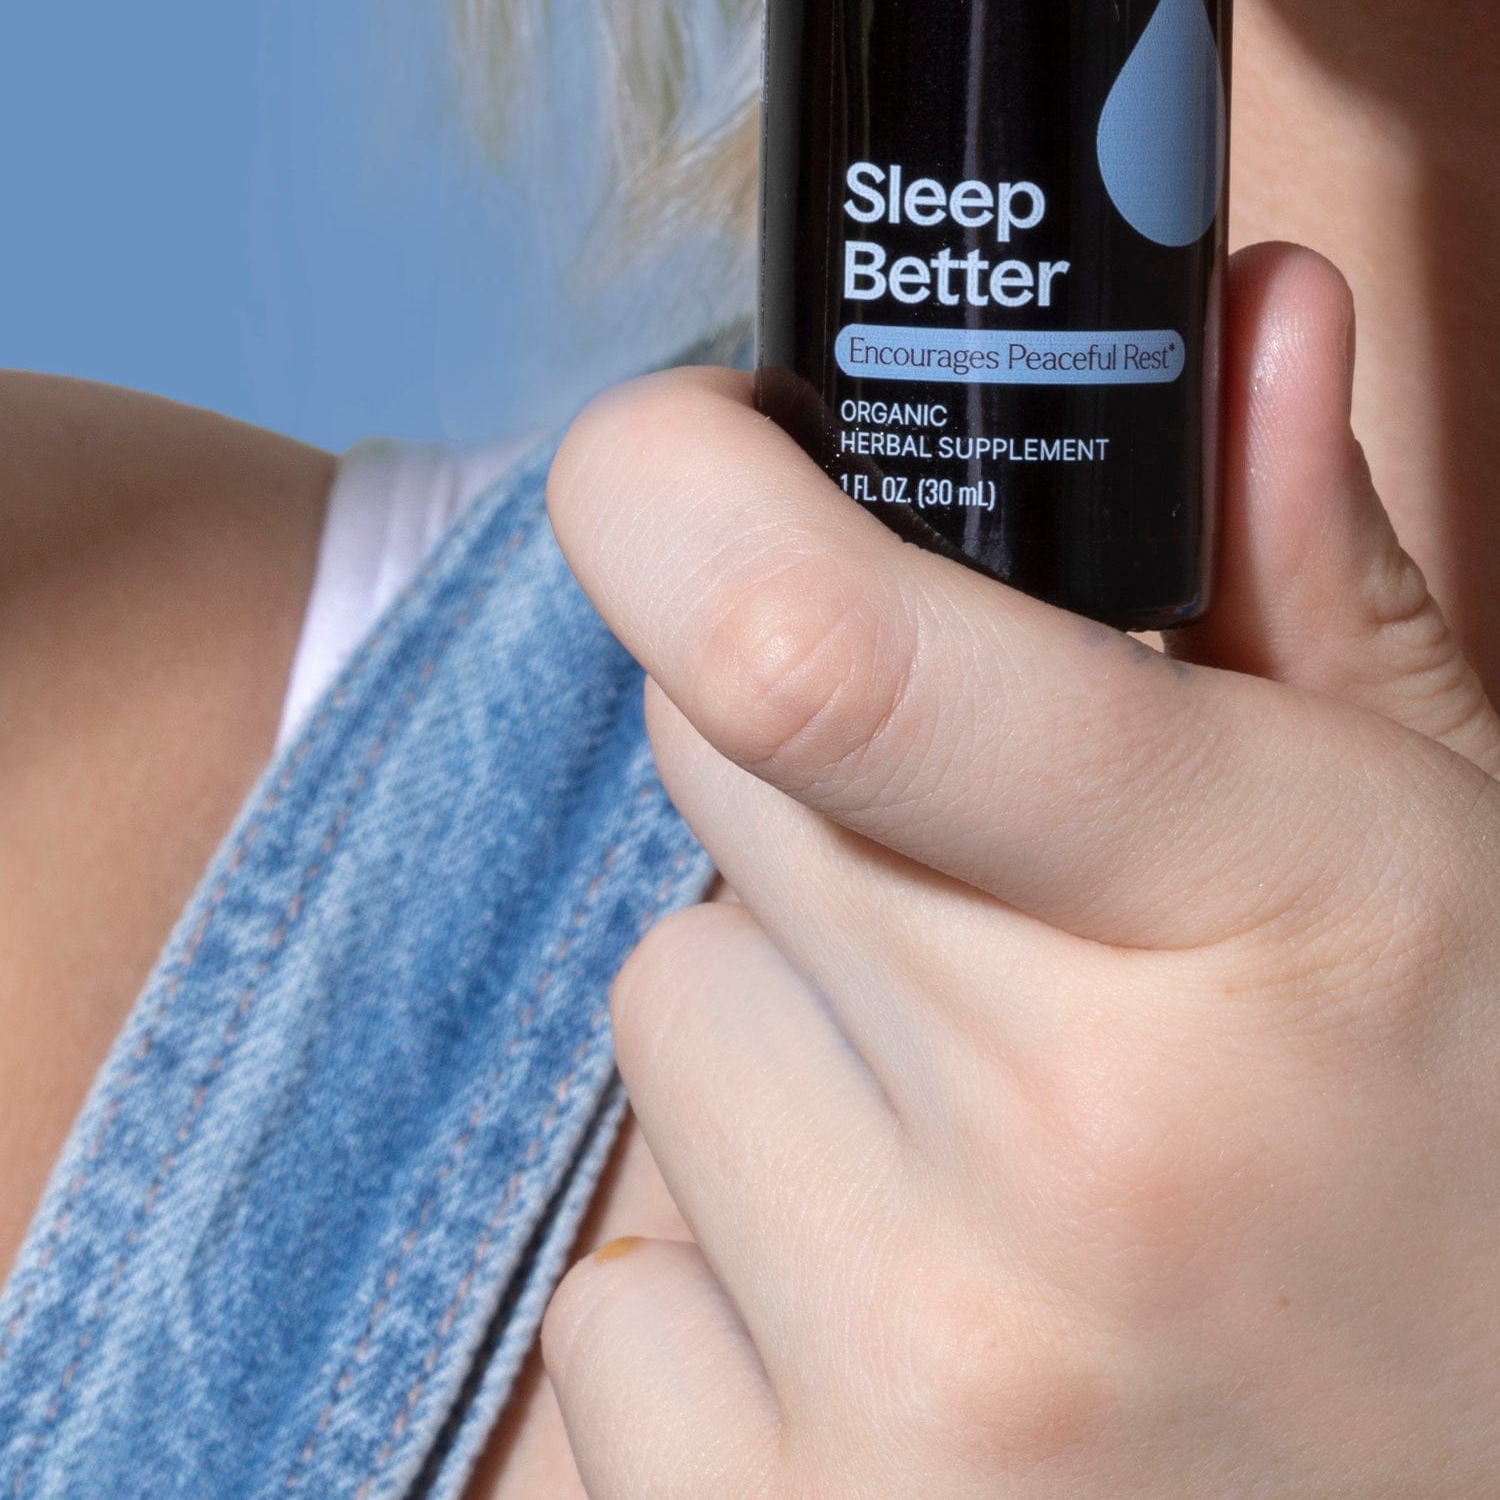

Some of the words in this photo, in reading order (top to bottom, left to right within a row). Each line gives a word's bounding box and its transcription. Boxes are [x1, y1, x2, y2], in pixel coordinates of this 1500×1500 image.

[843, 161, 1045, 242] Sleep
[843, 240, 1070, 307] Better
[850, 337, 999, 375] Encourages
[1008, 343, 1117, 370] Peaceful
[840, 399, 948, 427] ORGANIC
[840, 431, 932, 458] HERBAL
[938, 437, 1109, 461] SUPPLEMENT
[840, 474, 848, 492] 1
[854, 474, 877, 502] FL.
[882, 476, 912, 504] OZ.
[918, 478, 953, 509] (30
[958, 480, 996, 512] mL)
